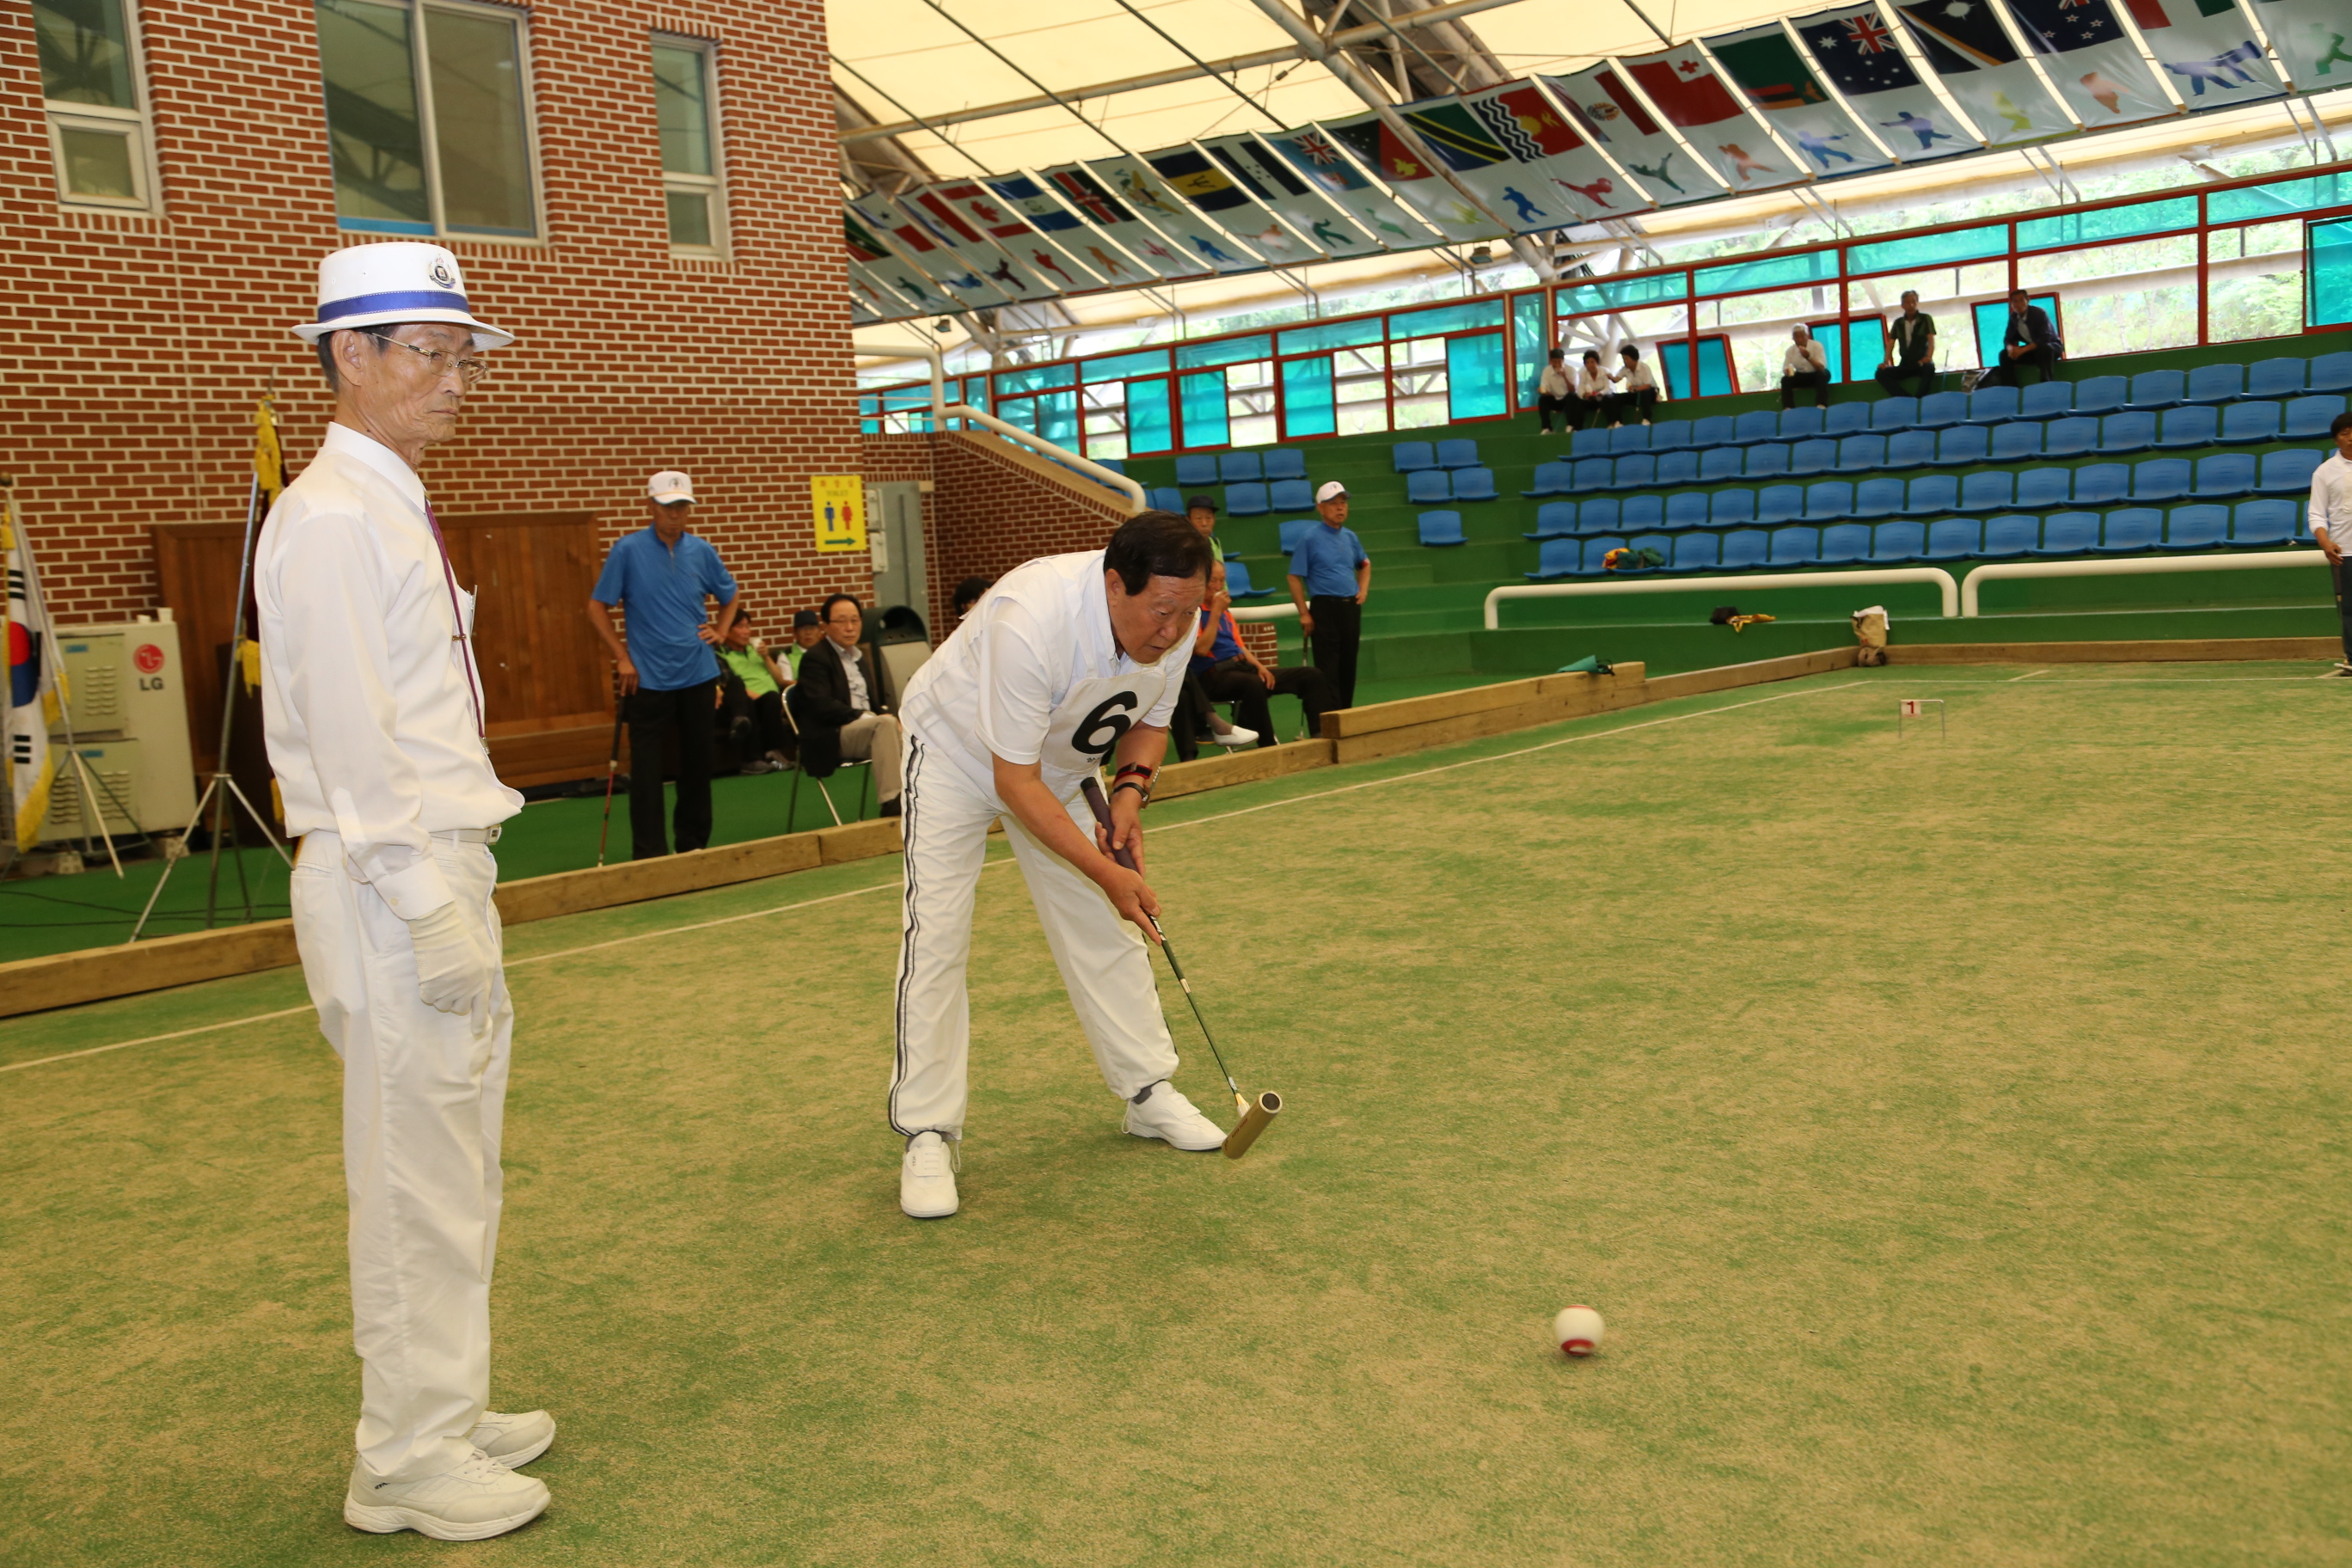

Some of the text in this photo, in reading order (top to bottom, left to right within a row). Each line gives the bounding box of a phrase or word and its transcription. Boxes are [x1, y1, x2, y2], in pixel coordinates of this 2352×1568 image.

[139, 677, 164, 691] LG
[1906, 701, 1914, 714] 1
[1071, 690, 1138, 754] 6
